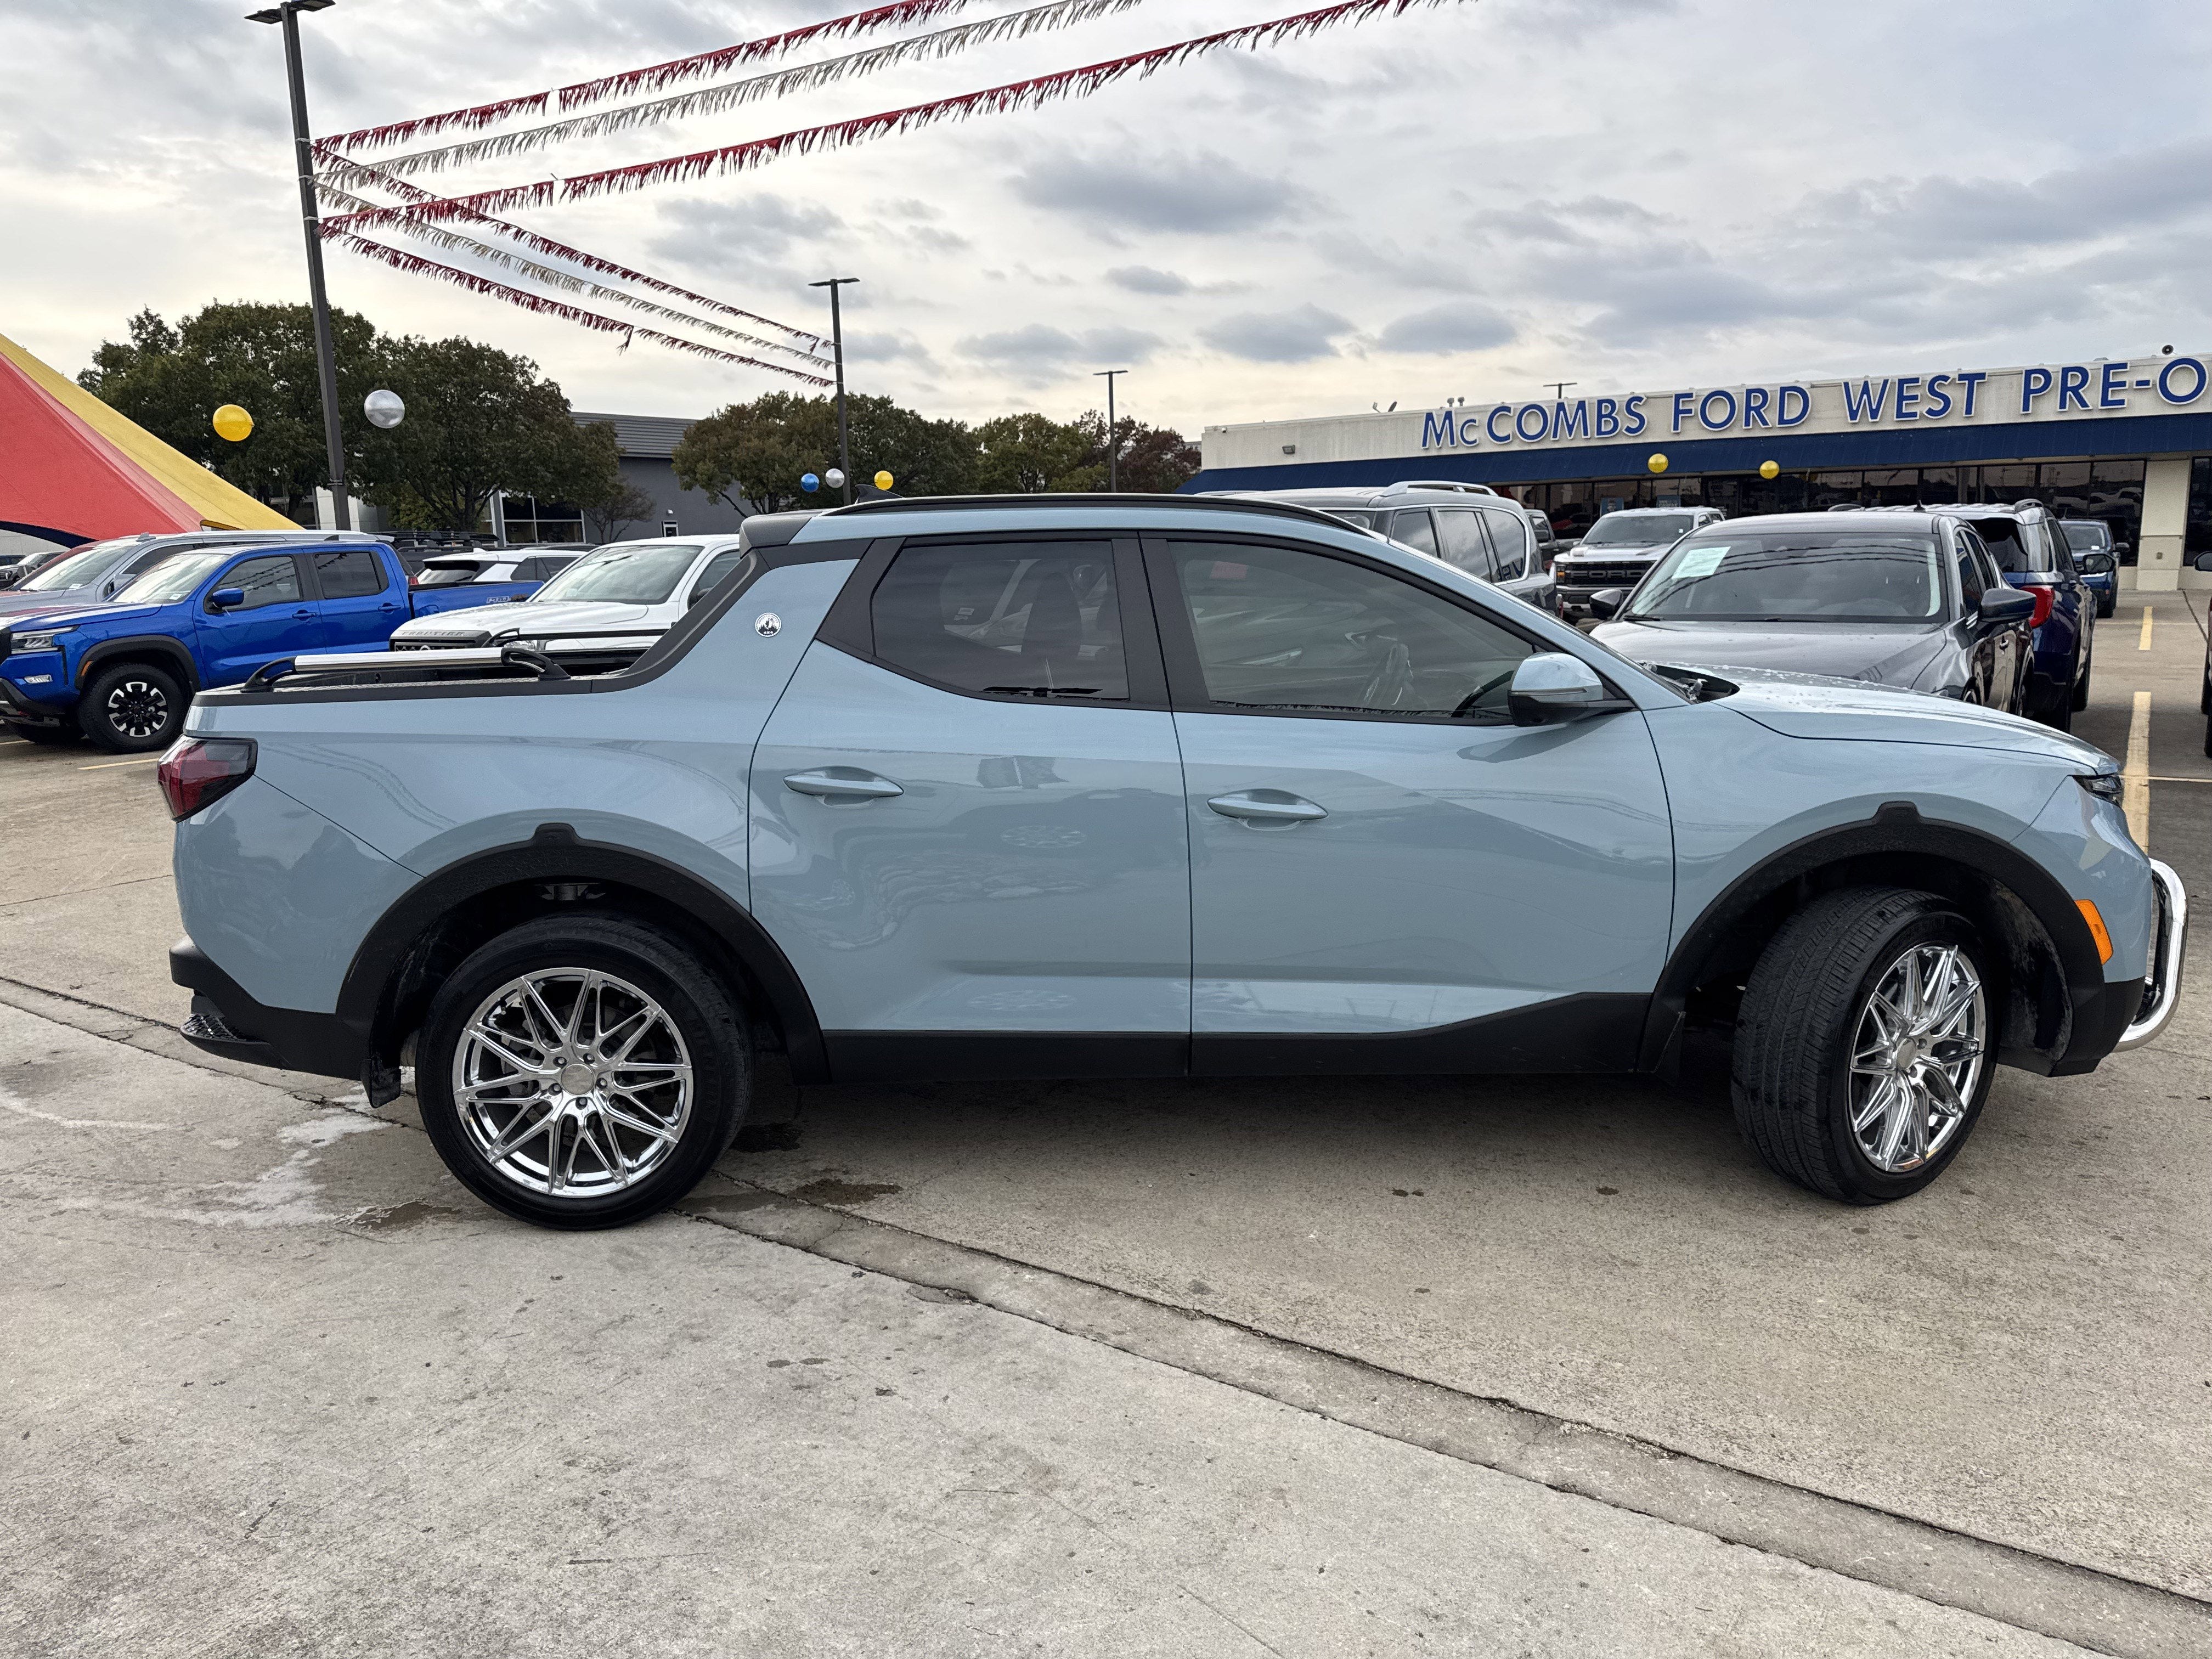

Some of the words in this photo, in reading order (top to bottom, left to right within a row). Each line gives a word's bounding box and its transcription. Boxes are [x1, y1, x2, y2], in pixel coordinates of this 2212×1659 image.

[1422, 394, 1646, 448] McCOMBS
[1672, 385, 1811, 433] FORD
[1843, 371, 1988, 422] WEST
[1571, 570, 1647, 578] FORD
